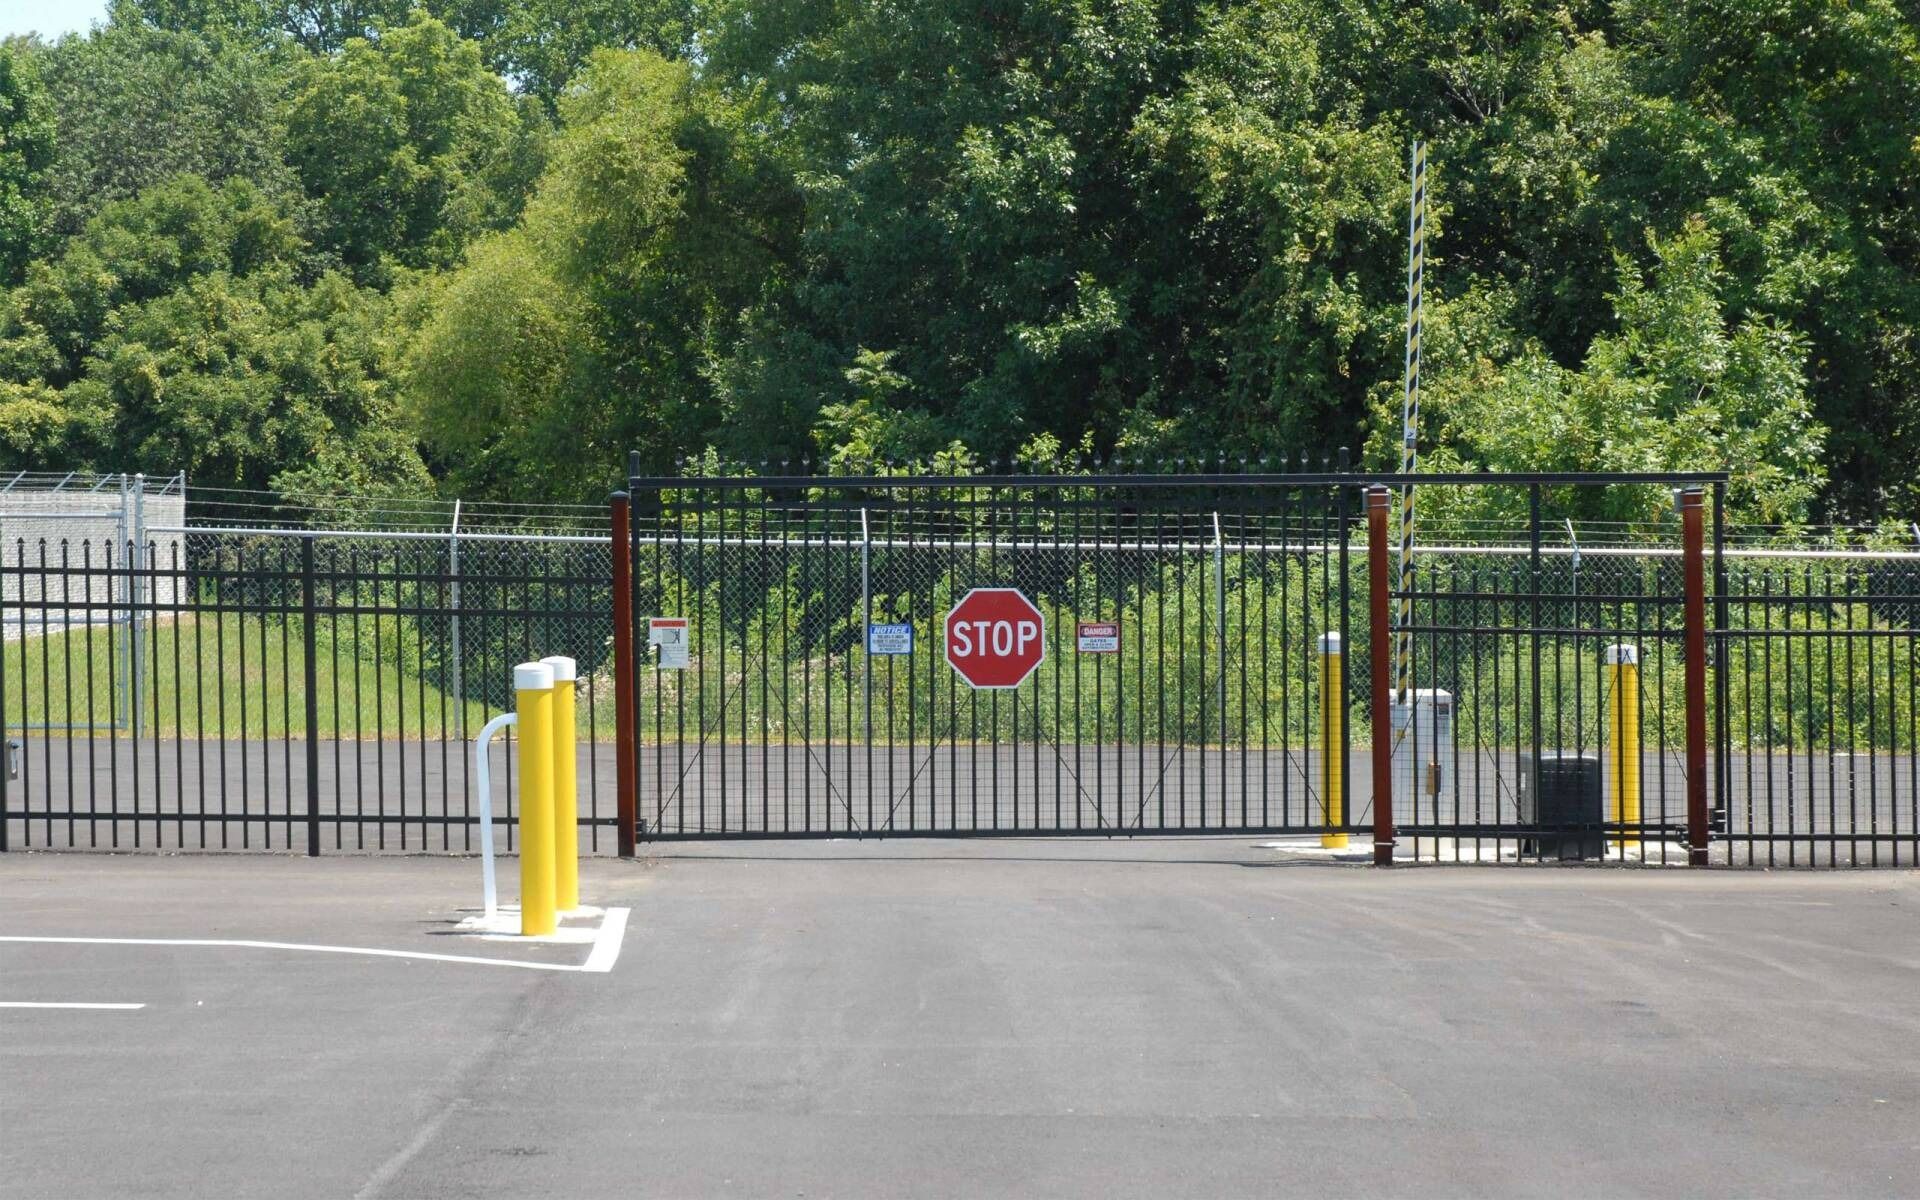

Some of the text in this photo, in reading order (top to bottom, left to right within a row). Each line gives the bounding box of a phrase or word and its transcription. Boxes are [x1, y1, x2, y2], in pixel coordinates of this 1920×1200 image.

[873, 626, 907, 634] NOTICE
[1084, 627, 1113, 635] DANGER
[953, 621, 1037, 657] STOP
